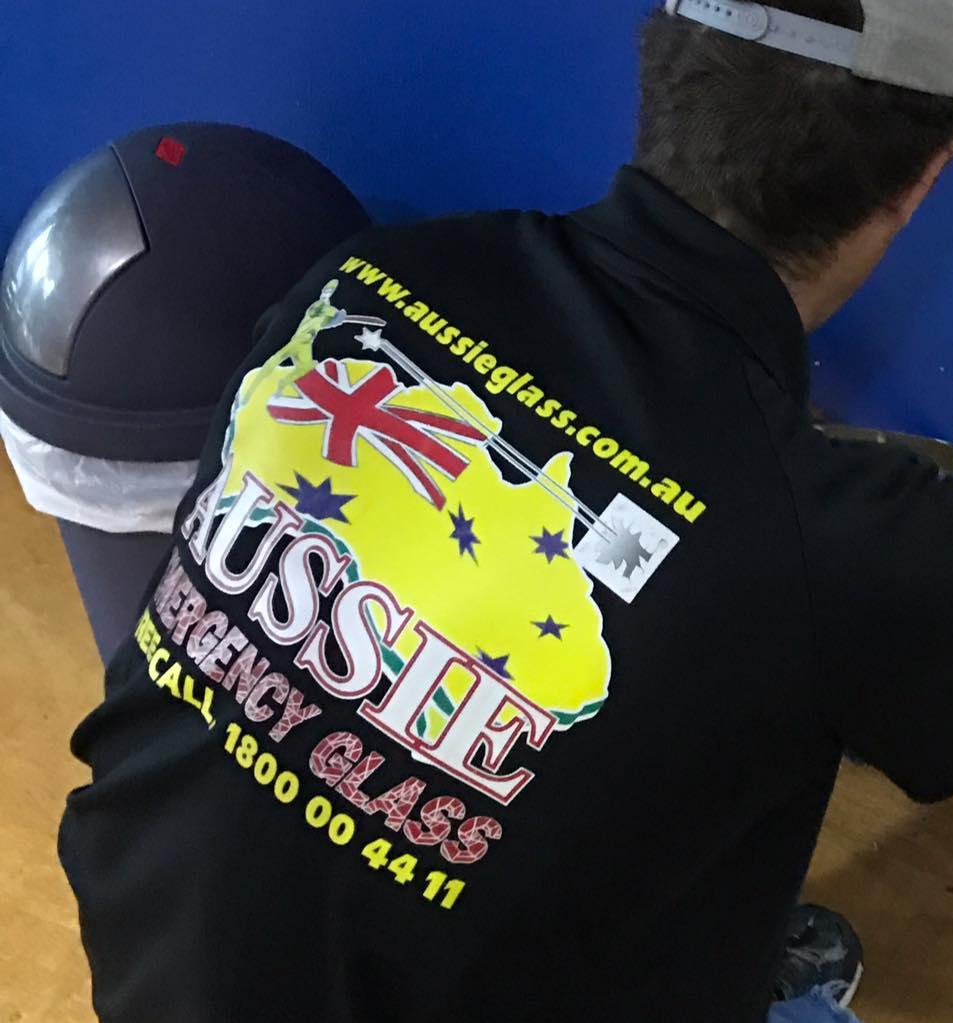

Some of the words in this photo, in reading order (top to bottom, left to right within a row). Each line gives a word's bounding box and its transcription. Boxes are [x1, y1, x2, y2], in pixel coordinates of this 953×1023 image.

[339, 256, 706, 522] www.aussieglass.com.au
[181, 452, 558, 806] AUSSIE
[224, 723, 299, 803] 1800
[305, 796, 355, 845] 00
[361, 838, 418, 884] 44
[423, 871, 465, 910] 11
[309, 731, 502, 863] GLASS
